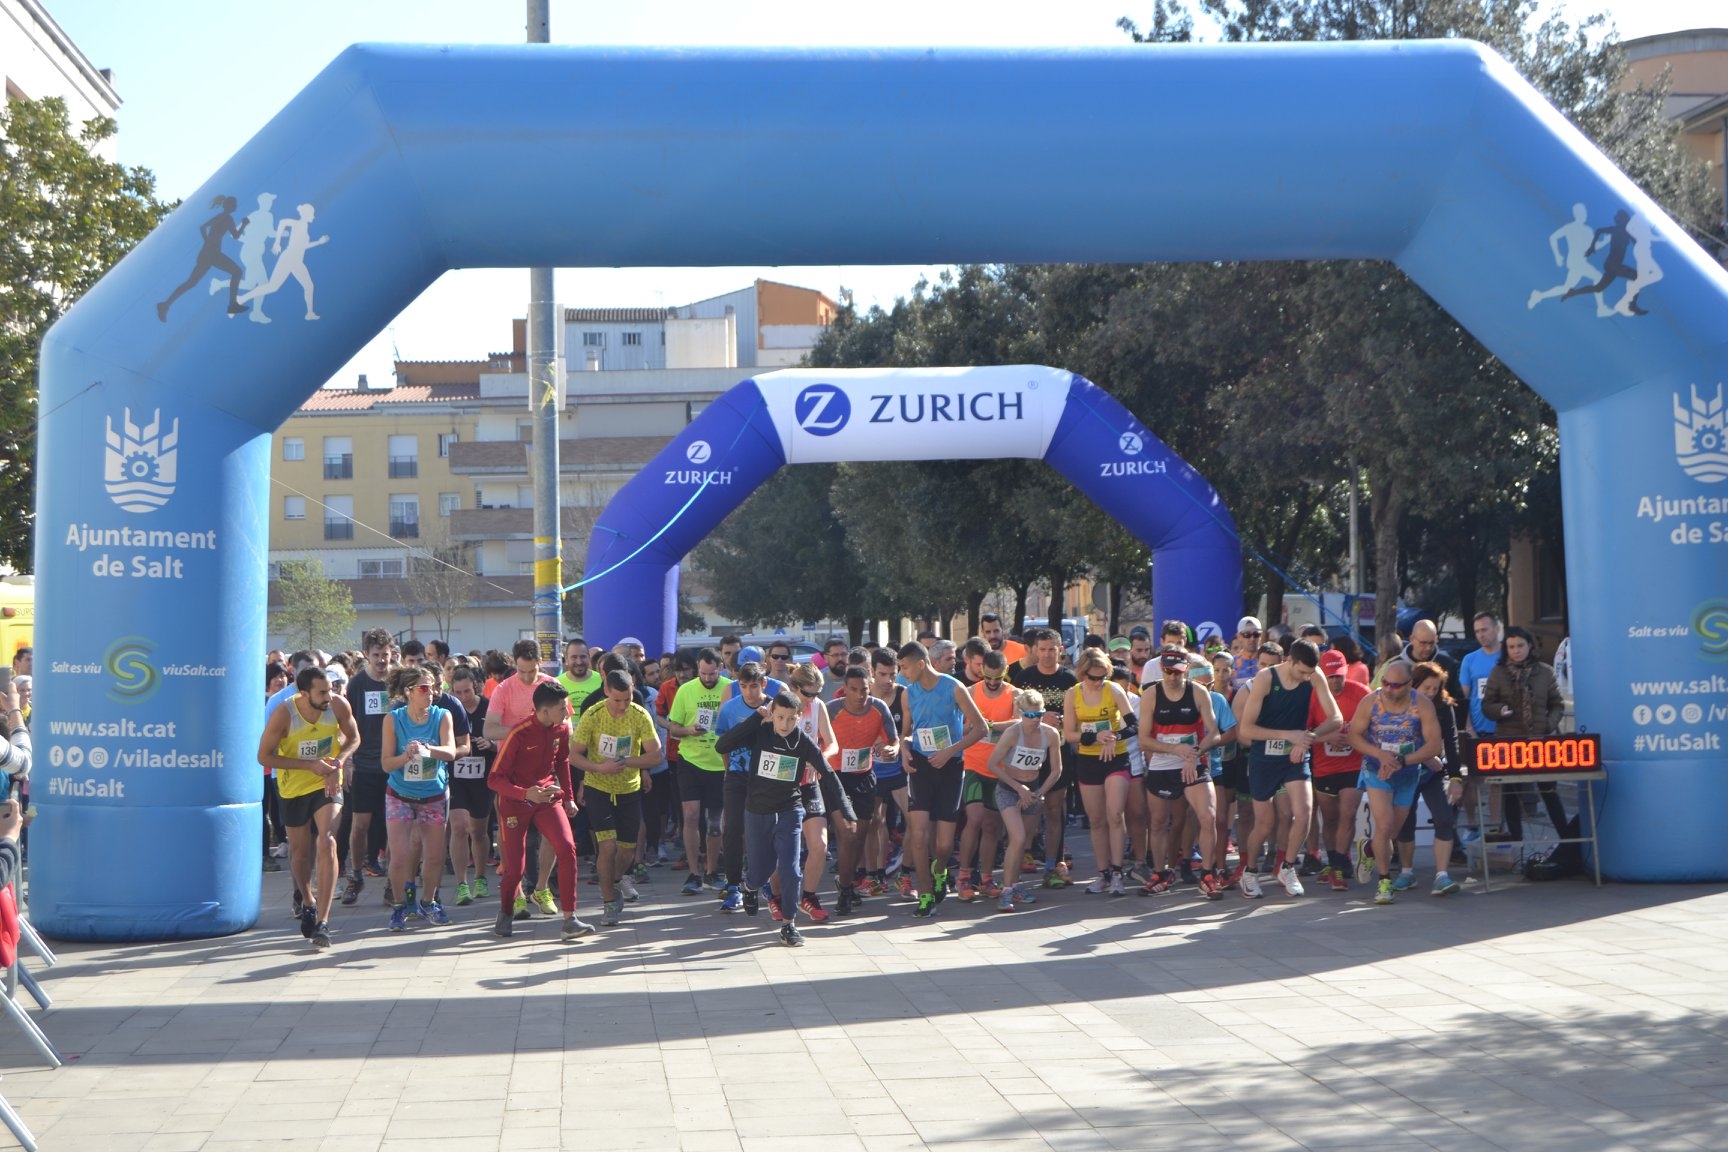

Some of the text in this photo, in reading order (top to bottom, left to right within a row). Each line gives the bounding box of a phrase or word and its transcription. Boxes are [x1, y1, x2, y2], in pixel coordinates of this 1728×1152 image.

[869, 391, 1024, 423] ZURICH
[1100, 460, 1167, 477] ZURICH
[664, 470, 732, 485] ZURICH
[1636, 494, 1728, 523] Ajunta
[65, 523, 216, 551] Ajuntament
[1670, 522, 1703, 544] de
[93, 554, 184, 579] de Salt
[1628, 624, 1689, 638] Salt es viu
[51, 661, 102, 674] Salt es viu
[162, 664, 226, 677] viuSalt.cat
[368, 698, 378, 709] 29
[699, 714, 710, 725] 86
[50, 718, 176, 738] www.salt.cat
[922, 734, 932, 746] 11
[1268, 739, 1284, 750] 145
[1633, 732, 1720, 752] #ViuSalt
[300, 745, 317, 756] 139
[602, 741, 613, 753] 71
[113, 749, 224, 768] /viladesalt
[846, 756, 856, 767] 12
[1016, 753, 1040, 766] 703
[407, 764, 419, 775] 49
[457, 763, 481, 774] 711
[762, 759, 776, 772] 87
[49, 777, 125, 798] #ViuSalt
